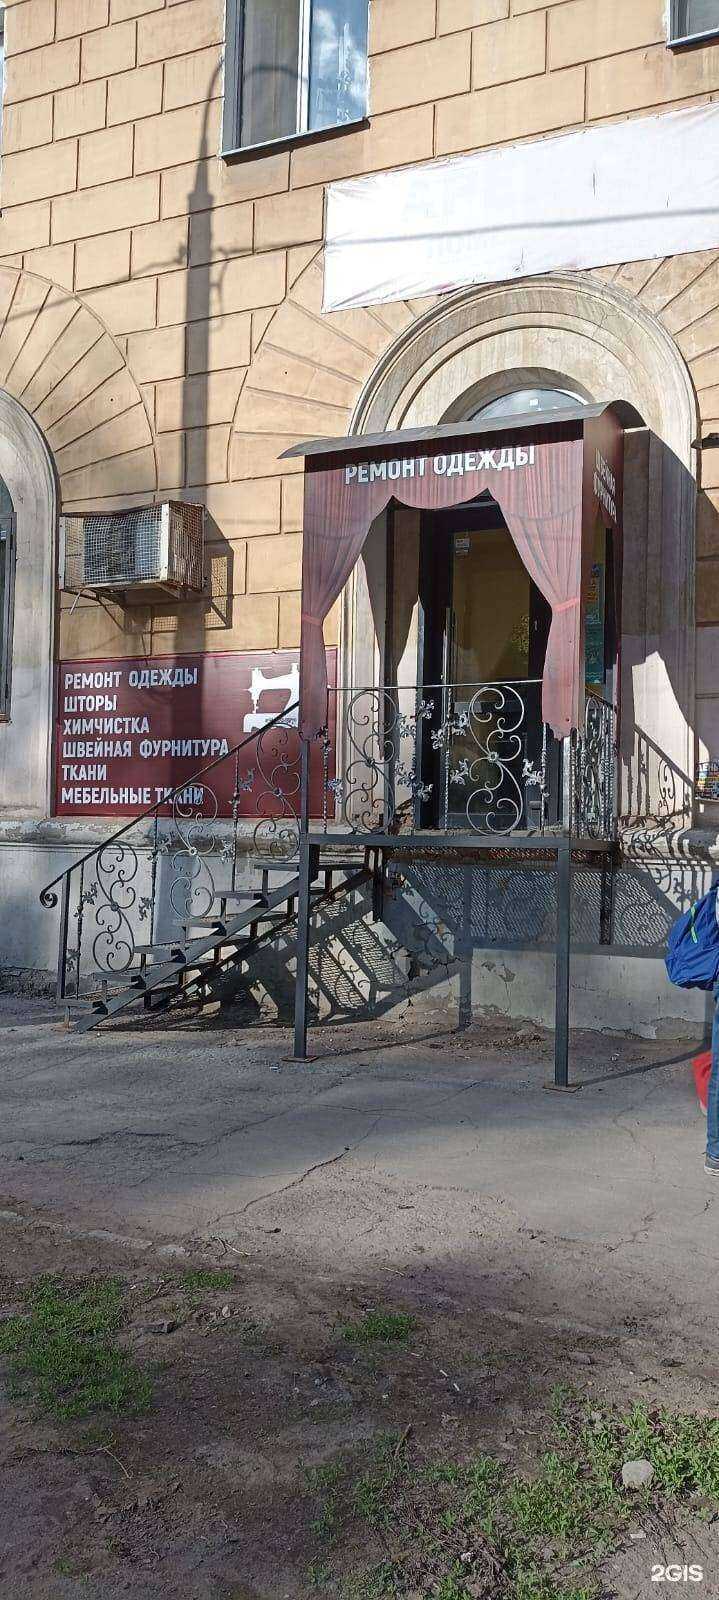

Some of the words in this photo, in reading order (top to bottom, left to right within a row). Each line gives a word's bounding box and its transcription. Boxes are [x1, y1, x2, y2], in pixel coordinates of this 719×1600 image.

[345, 457, 428, 484] РЕМОНТ
[433, 445, 535, 477] ОДЕЖДЫ
[64, 672, 121, 689] РЕМОНТ
[128, 668, 198, 688] ОДЕЖДЫ
[64, 694, 117, 712] ШТОРЫ
[63, 717, 149, 735] ХИМЧИСТКА
[63, 738, 132, 758] ШВЕЙНАЯ
[139, 739, 229, 759] ФУРНИТУРА
[62, 765, 107, 781] ТКАНИ
[61, 787, 151, 804] МЕБЕЛЬНЫЕ
